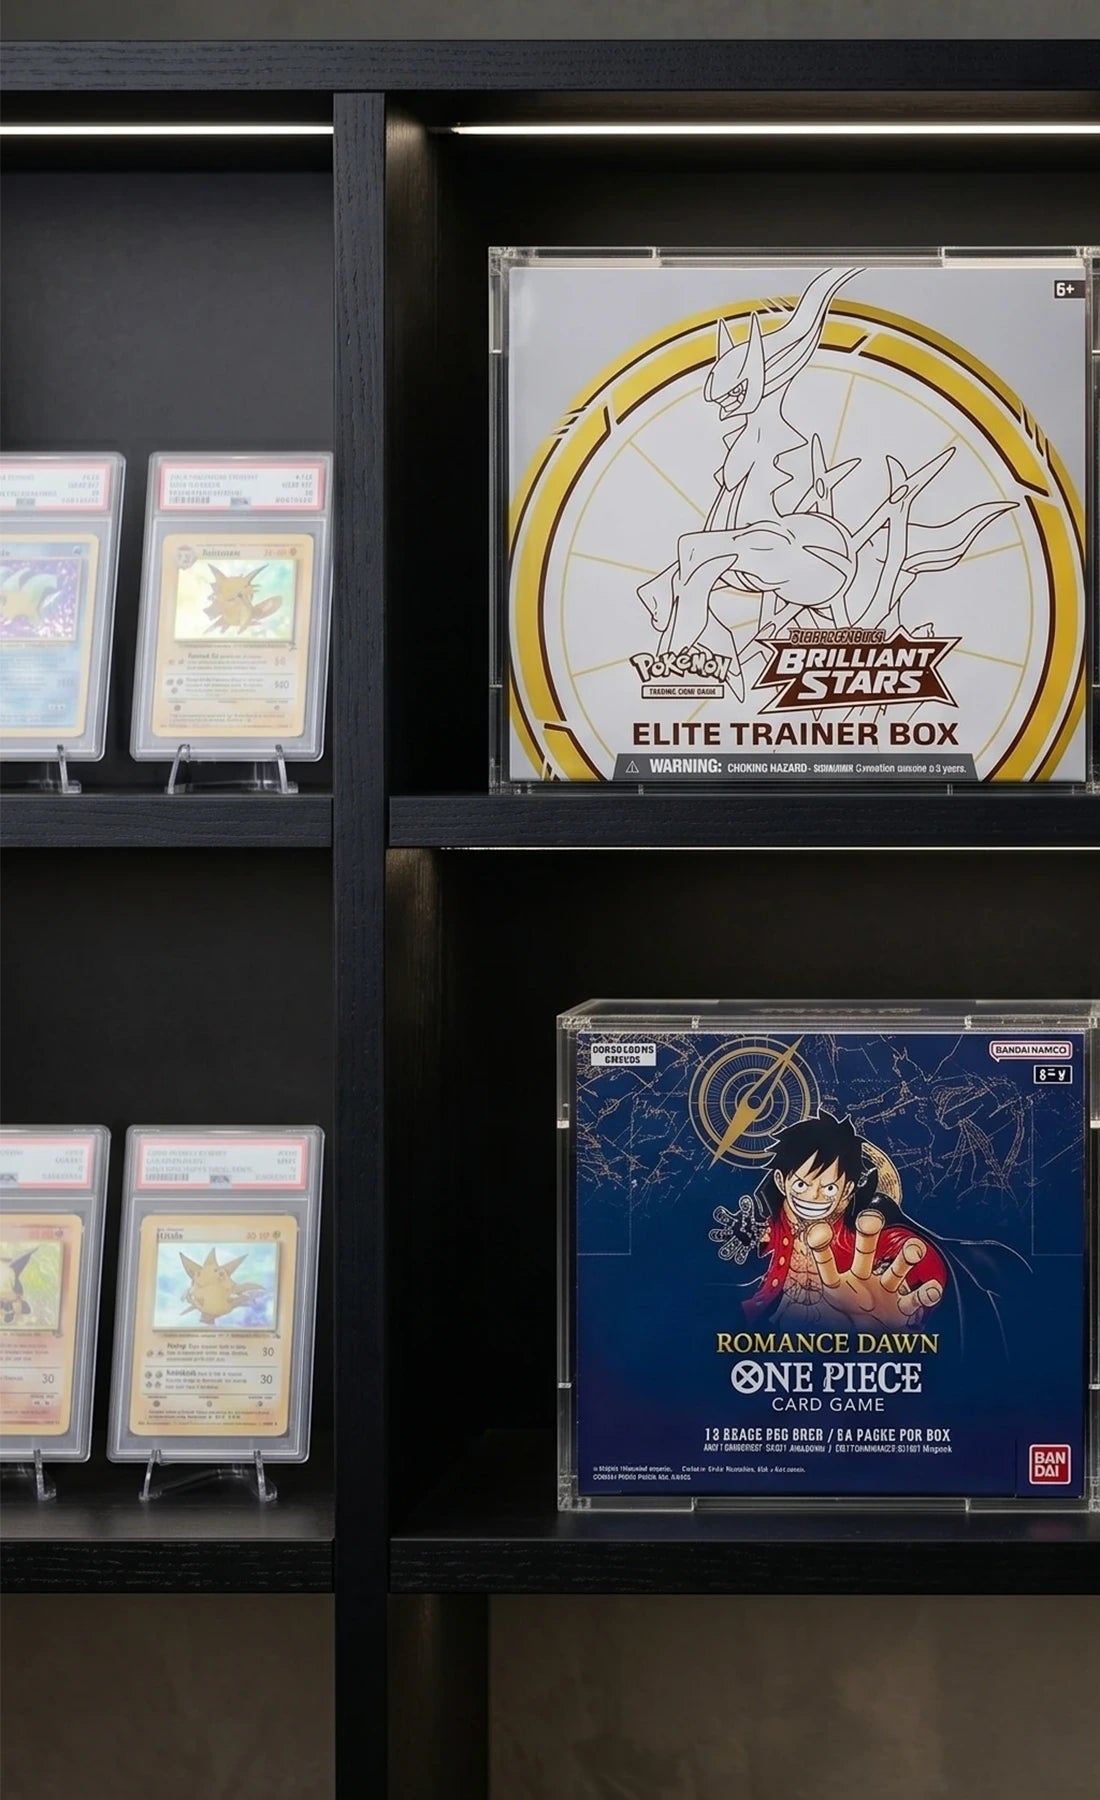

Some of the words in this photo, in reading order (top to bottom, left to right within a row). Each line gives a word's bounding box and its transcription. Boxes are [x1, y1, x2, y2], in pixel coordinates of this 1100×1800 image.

[1056, 282, 1075, 297] 6+
[776, 648, 935, 674] BRILLIANT
[797, 670, 923, 700] STARS
[632, 722, 721, 746] ELITE
[730, 722, 878, 746] TRAINER
[890, 722, 959, 746] BOX
[650, 758, 722, 773] WARNING:
[728, 763, 767, 772] CHOKING
[996, 1046, 1030, 1054] BANDAI
[1032, 1046, 1067, 1054] NAMCO
[716, 1333, 849, 1353] ROMANCE
[857, 1333, 939, 1353] DAWN
[731, 1360, 812, 1393] ONE
[823, 1362, 922, 1393] PIECE
[772, 1398, 821, 1411] CARD
[830, 1398, 884, 1411] GAME
[926, 1428, 951, 1441] BOX
[1034, 1452, 1066, 1464] BAN
[1034, 1465, 1059, 1477] DAI
